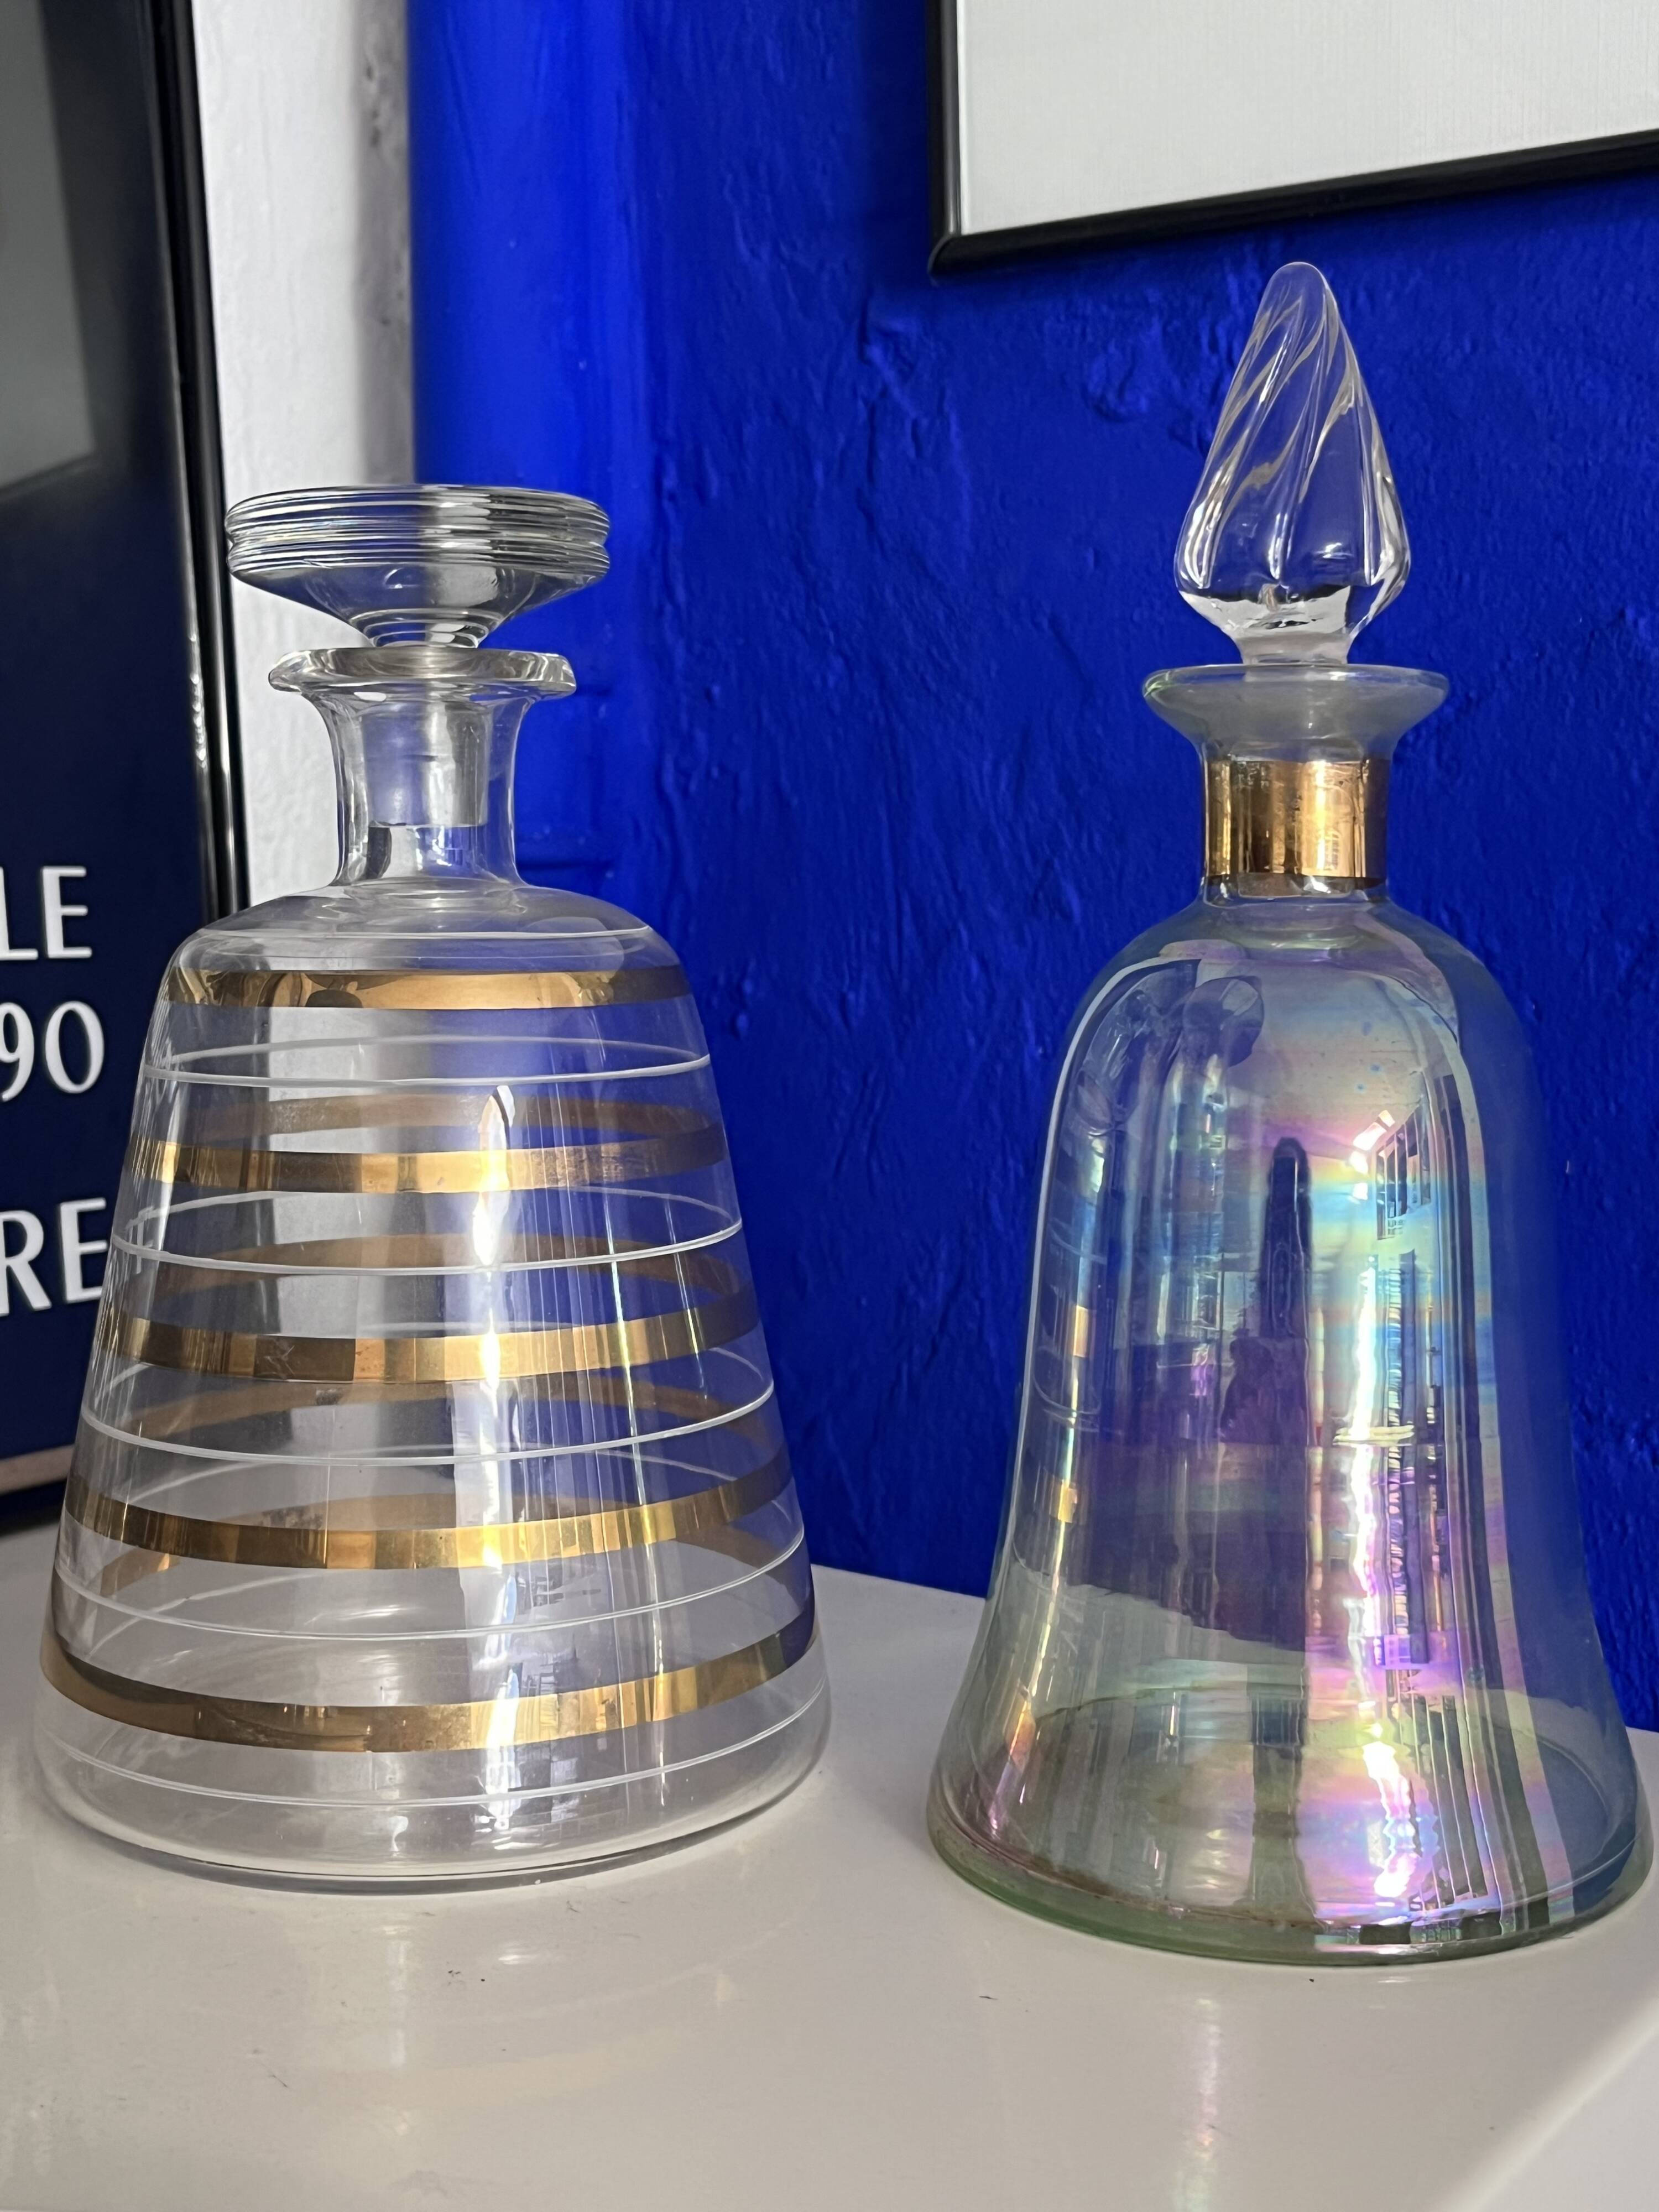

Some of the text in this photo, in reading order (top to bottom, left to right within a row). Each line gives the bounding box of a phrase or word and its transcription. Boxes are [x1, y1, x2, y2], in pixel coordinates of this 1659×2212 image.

[0, 866, 92, 960] LE
[0, 1000, 105, 1102] 90
[0, 1197, 107, 1316] RE
